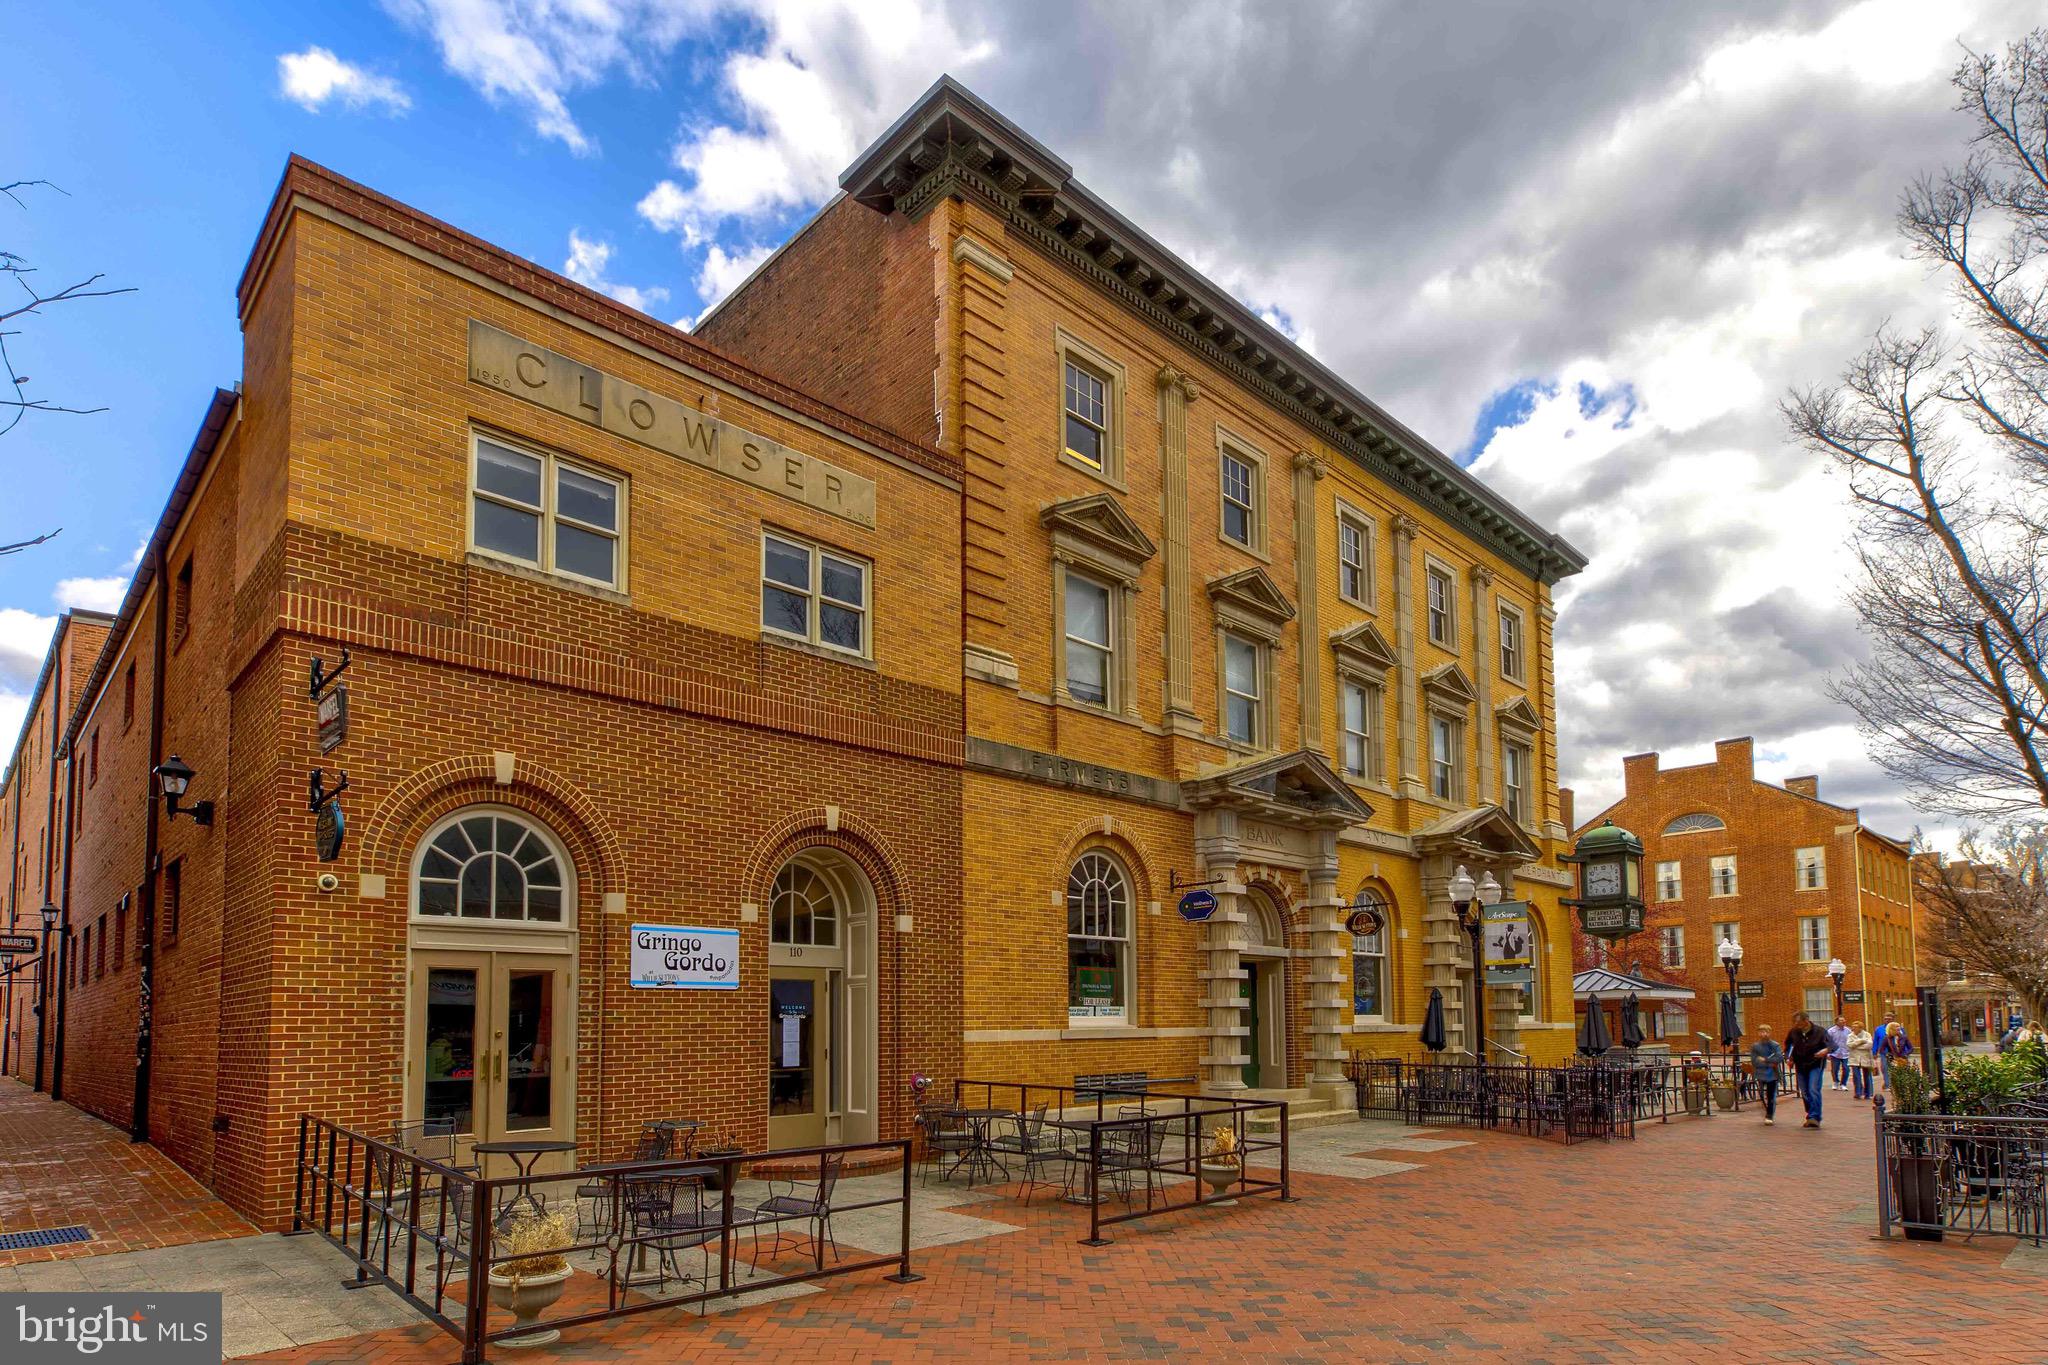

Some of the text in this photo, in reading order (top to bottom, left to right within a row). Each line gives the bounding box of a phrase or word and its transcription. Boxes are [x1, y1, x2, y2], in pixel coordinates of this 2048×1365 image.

[476, 367, 512, 389] 1950
[516, 352, 842, 505] CLOWSER
[846, 508, 872, 524] BLDG
[1032, 755, 1129, 791] FARMERS
[1246, 826, 1284, 847] BANK
[0, 938, 32, 947] WARFEL
[638, 932, 701, 955] Gringo
[789, 947, 803, 957] 110
[664, 951, 726, 972] Gordo
